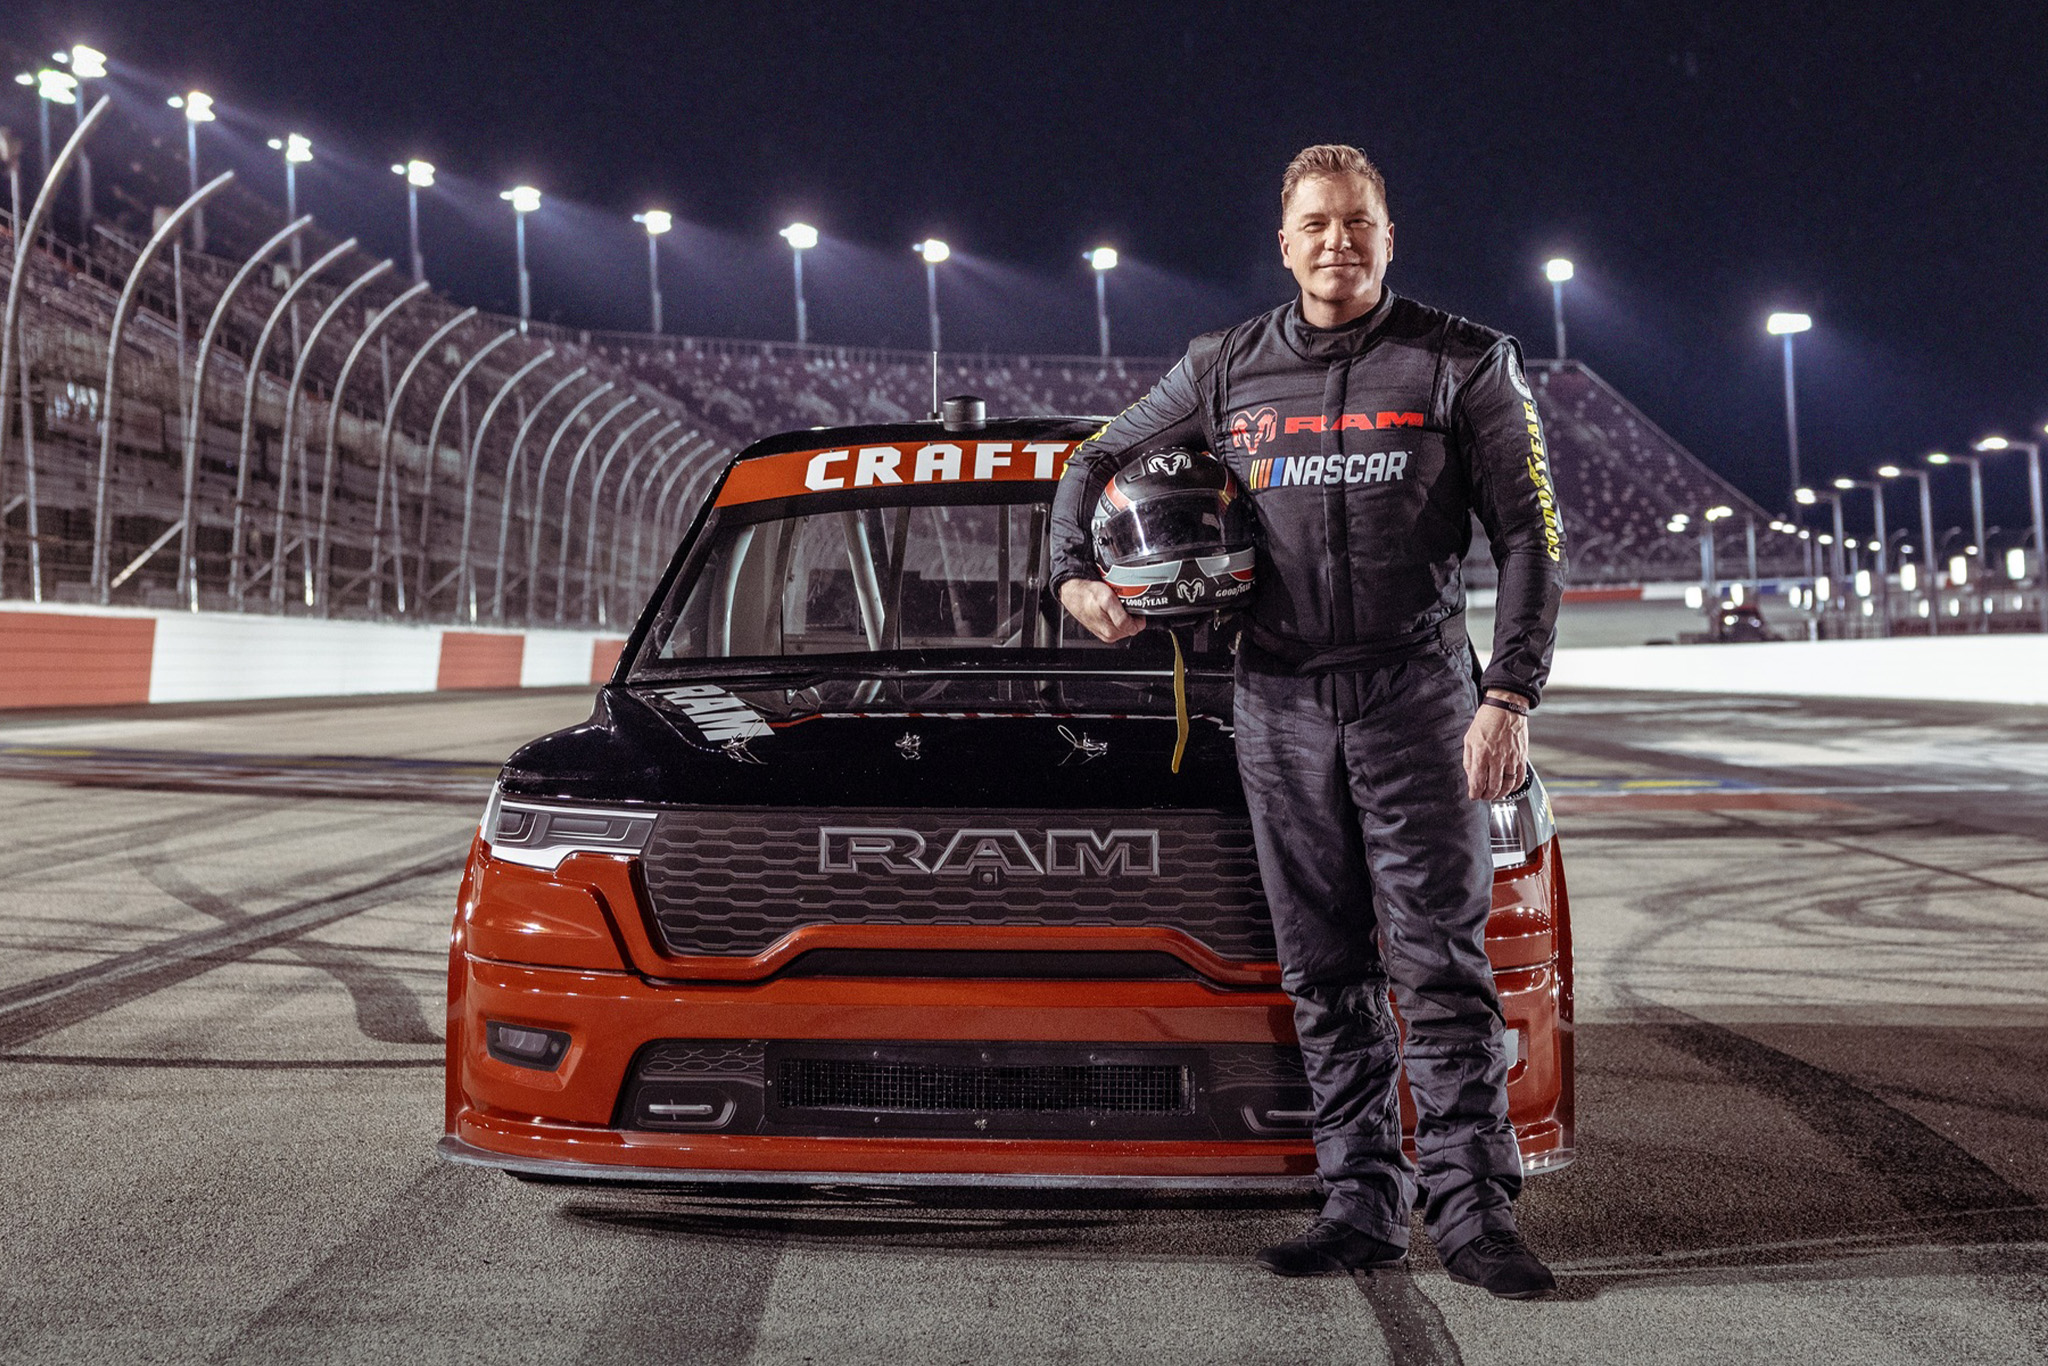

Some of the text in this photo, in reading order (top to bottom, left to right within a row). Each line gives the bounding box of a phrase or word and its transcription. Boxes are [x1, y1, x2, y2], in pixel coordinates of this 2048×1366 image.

[1284, 411, 1424, 434] RAM
[805, 443, 1069, 491] CRAFT
[1282, 451, 1408, 487] NASCAR
[652, 684, 775, 741] RAM
[818, 826, 1160, 877] RAM
